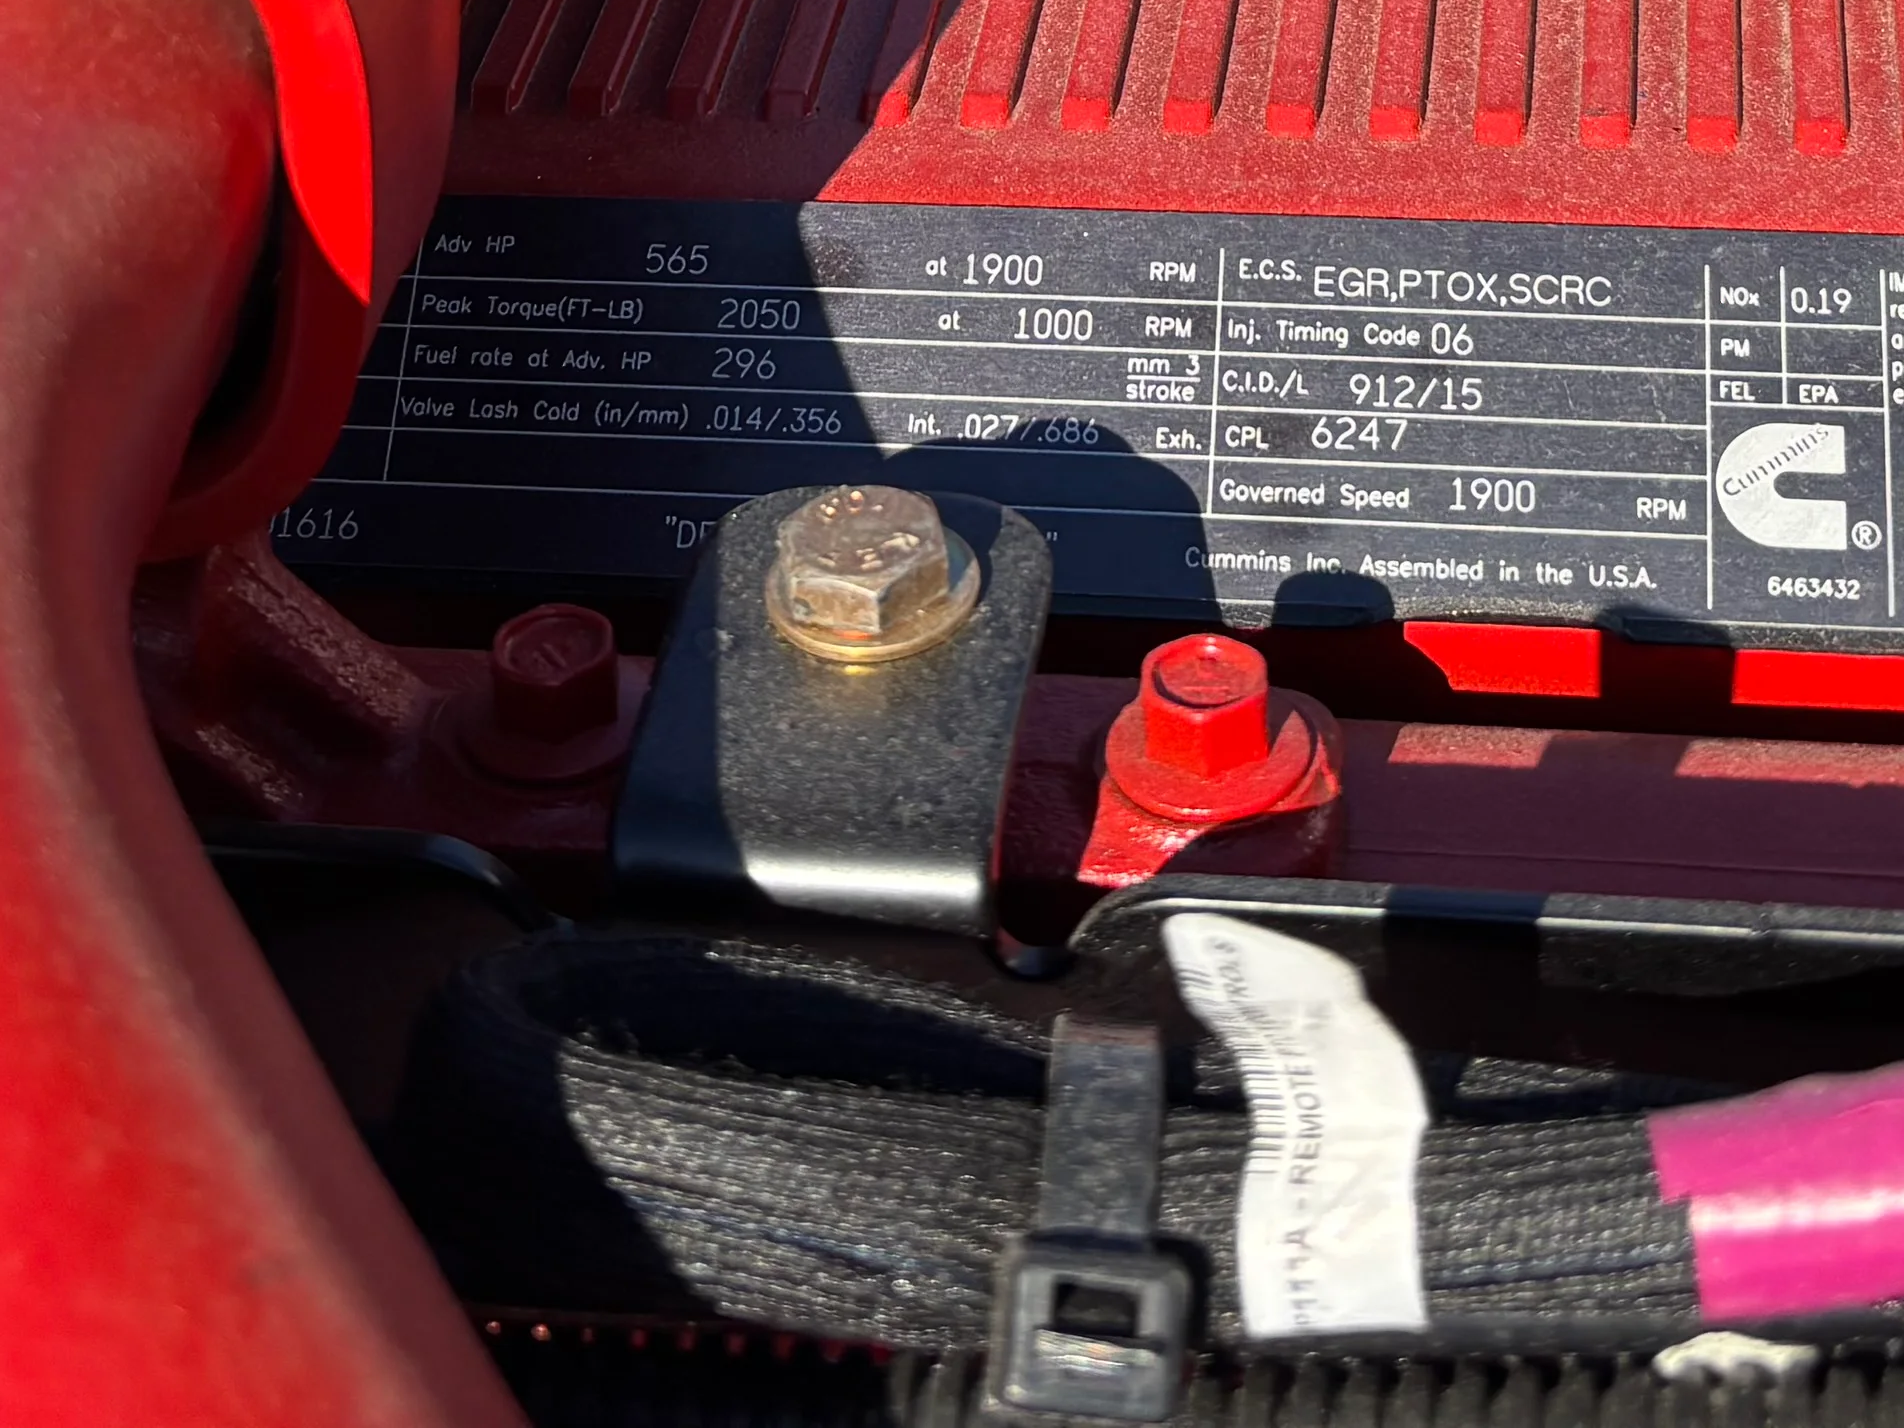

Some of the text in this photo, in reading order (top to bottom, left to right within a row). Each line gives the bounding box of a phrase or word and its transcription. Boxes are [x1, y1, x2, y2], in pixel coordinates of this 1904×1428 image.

[434, 234, 1197, 287] Adv HP 565 at 1900 RPM
[1239, 258, 1613, 305] E.C.S. EGR,PTOX,SCRC
[1719, 286, 1760, 307] NOx
[421, 294, 1192, 341] Peak Torque(FT-LB) 2050 at 1000 RPM
[1227, 320, 1474, 356] Inj. Timing Code 06
[1720, 338, 1750, 358] PM
[414, 345, 457, 364] Fuel
[471, 347, 513, 367] rate
[527, 348, 549, 368] at
[621, 351, 652, 370] HP
[712, 347, 776, 380] 296
[1128, 354, 1201, 376] mm 3
[1126, 381, 1196, 403] stroke
[1222, 369, 1483, 411] C.I.D./L 912/15
[1719, 381, 1839, 405] FEL EPA
[400, 397, 1201, 450] Valve Lash Cold (in/mm) .014/.356 Int. .027/.686 Exh.
[1224, 416, 1407, 451] CPL 6247
[1220, 477, 1687, 521] Governed Speed 1900 RPM
[1184, 546, 1658, 590] Cummins Inc. Assembled in the U.S.A.
[1767, 575, 1861, 600] 6463432
[1287, 1062, 1326, 1185] REMOTE
